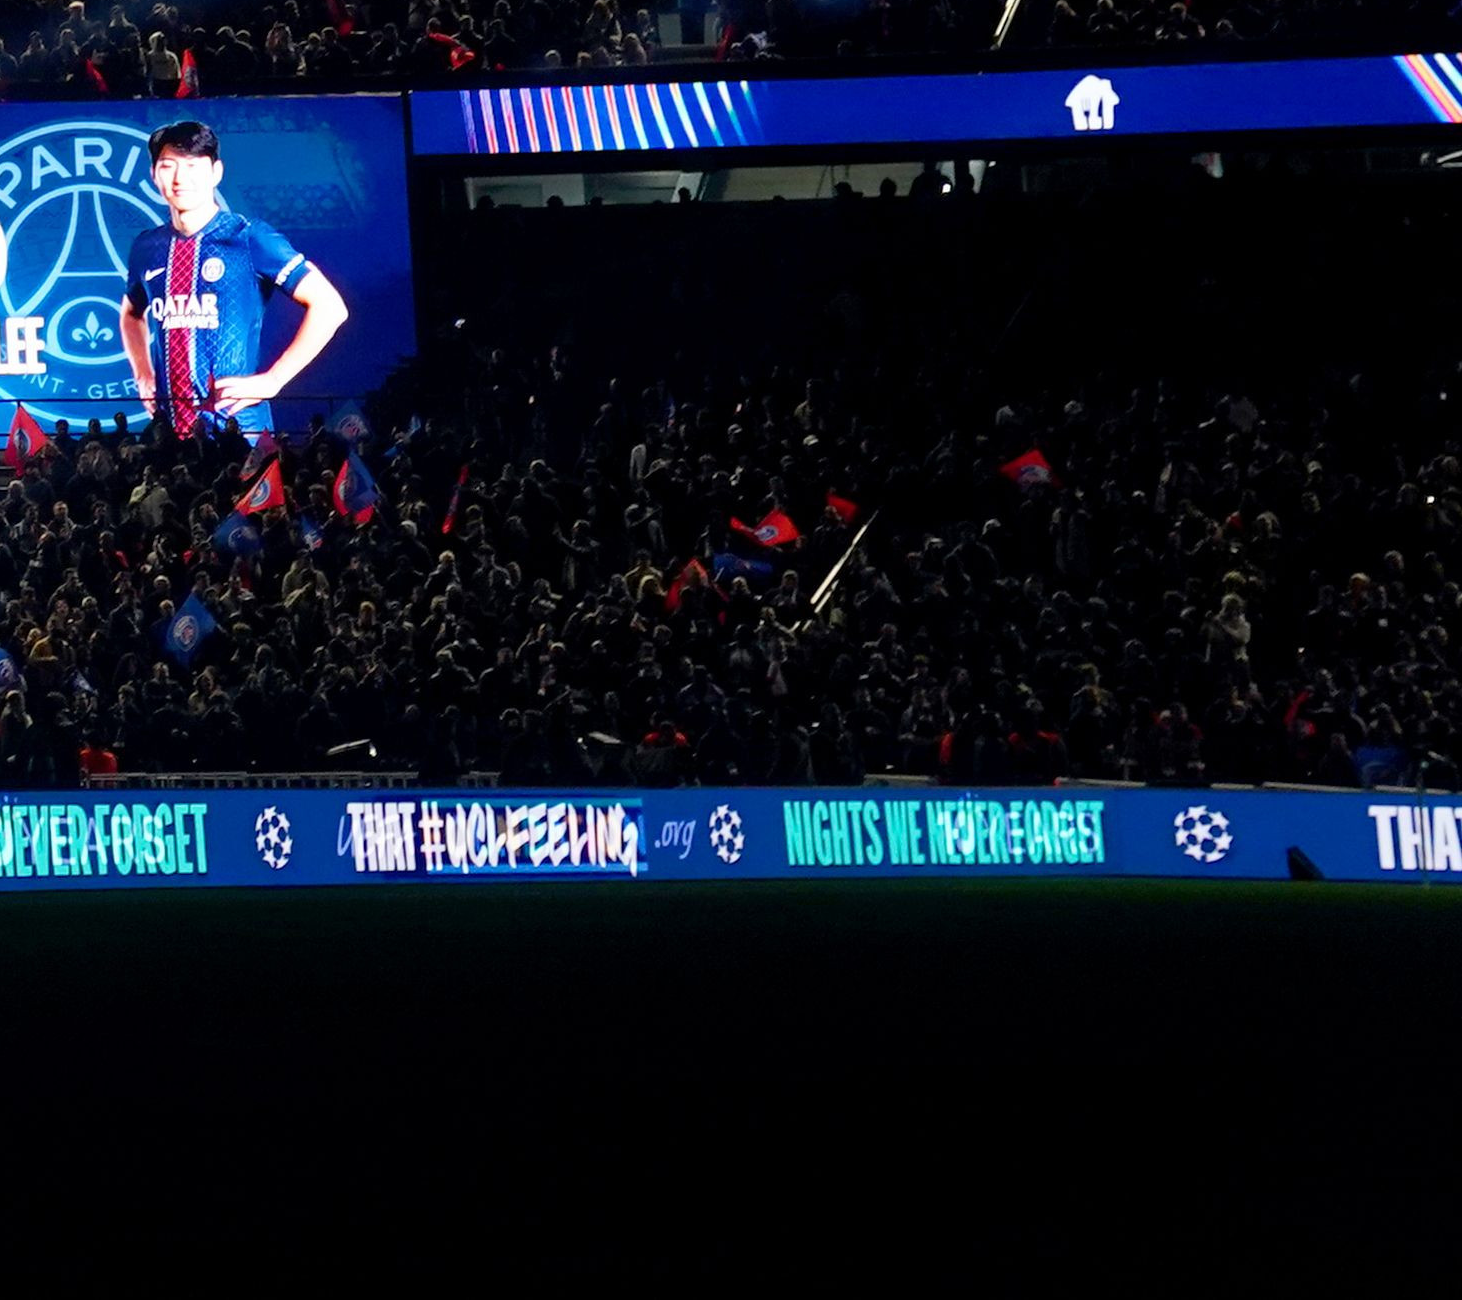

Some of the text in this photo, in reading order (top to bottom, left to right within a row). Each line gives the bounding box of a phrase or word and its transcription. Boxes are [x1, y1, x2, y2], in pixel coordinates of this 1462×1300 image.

[152, 293, 218, 321] QATAR
[94, 803, 208, 876] FORGET
[347, 802, 415, 872] THAT
[654, 818, 697, 860] .org
[783, 799, 1105, 867] NIGHTS WE NEVER FORGET
